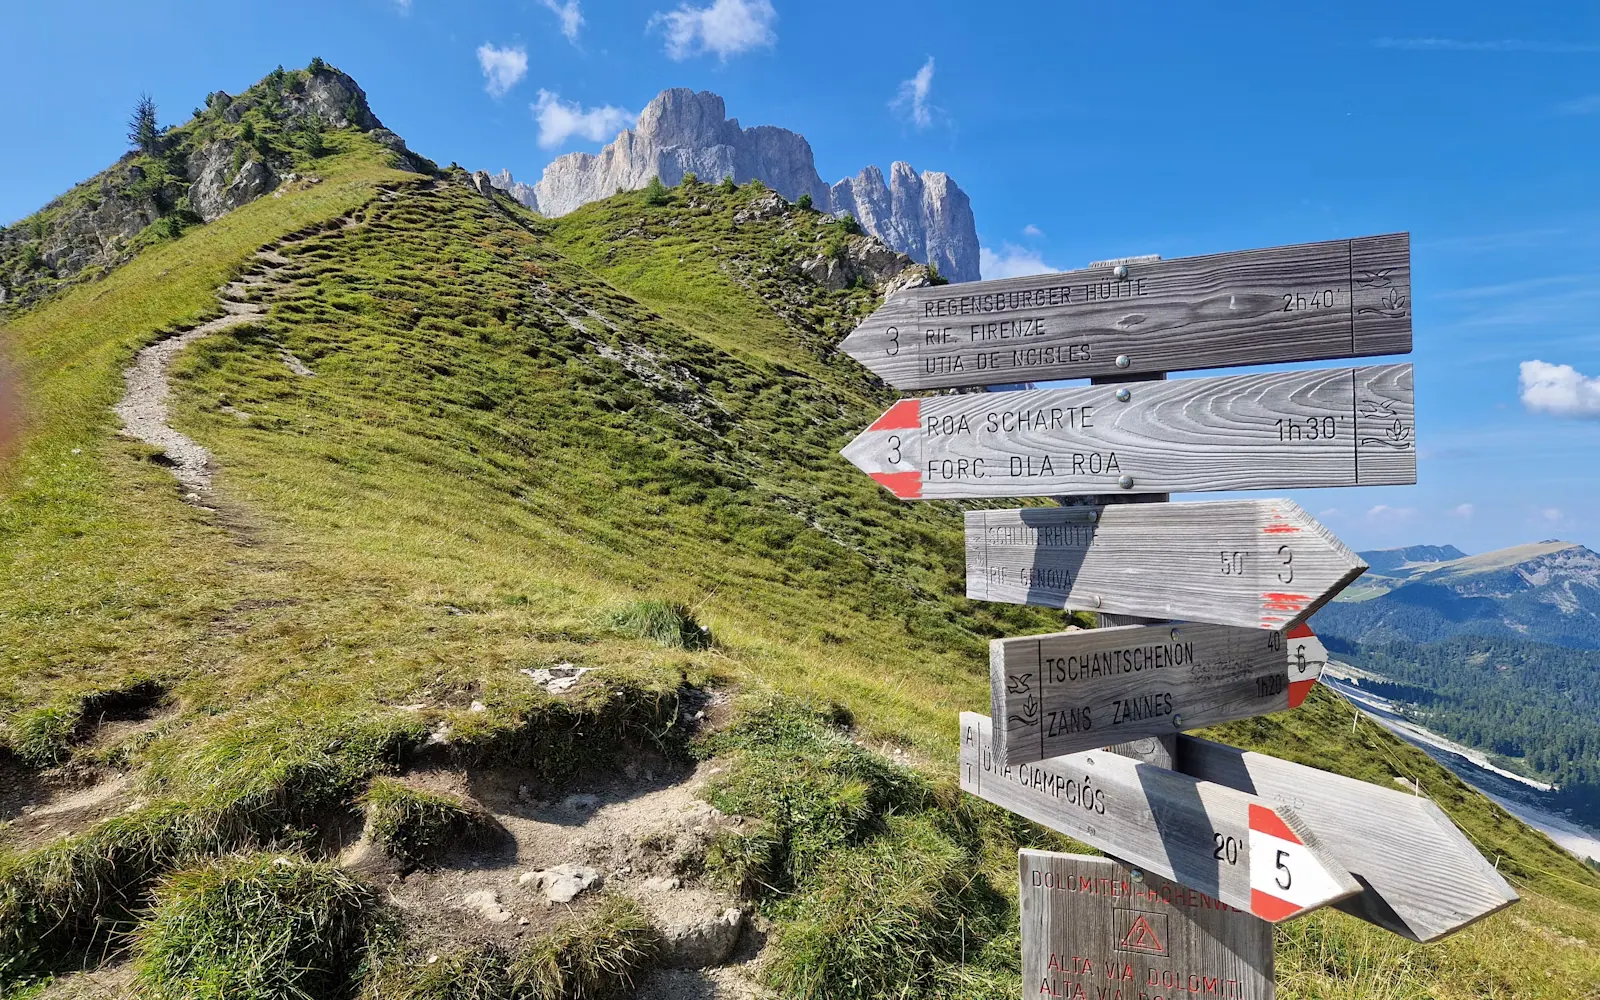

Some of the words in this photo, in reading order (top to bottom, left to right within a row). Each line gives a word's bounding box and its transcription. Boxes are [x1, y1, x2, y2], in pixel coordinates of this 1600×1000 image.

[924, 286, 1072, 319] REGENSBURGER
[1084, 277, 1149, 302] HÜTTE
[925, 327, 958, 346] RIF.
[970, 318, 1046, 342] FIRENZE
[1282, 289, 1341, 312] 2h40'
[885, 325, 899, 356] 3
[926, 355, 964, 374] UTIA
[977, 351, 1000, 370] DE
[1013, 343, 1092, 367] NCISLES
[927, 414, 971, 437] ROA
[986, 406, 1094, 433] SCHARTE
[887, 435, 902, 464] 3
[927, 458, 992, 480] FORC.
[1010, 455, 1055, 477] DLA
[1072, 452, 1121, 475] ROA
[1274, 415, 1344, 442] 1h30'
[1020, 567, 1073, 590] GENOVA
[1220, 551, 1249, 575] 50'
[1277, 545, 1294, 584] 3
[1046, 641, 1193, 684] TSCHANTSCHENON
[1296, 644, 1306, 674] 6
[1047, 706, 1092, 738] ZANS
[1112, 692, 1173, 725] ZANNES
[1019, 763, 1105, 815] CIAMPCIÔS
[1213, 832, 1243, 865] 20'
[1275, 850, 1292, 891] 5
[1136, 926, 1147, 946] 2
[1039, 977, 1086, 1000] ALTA
[1048, 953, 1094, 976] ALTA
[1105, 961, 1134, 982] VIA
[1147, 967, 1244, 1000] DOLOMITI
